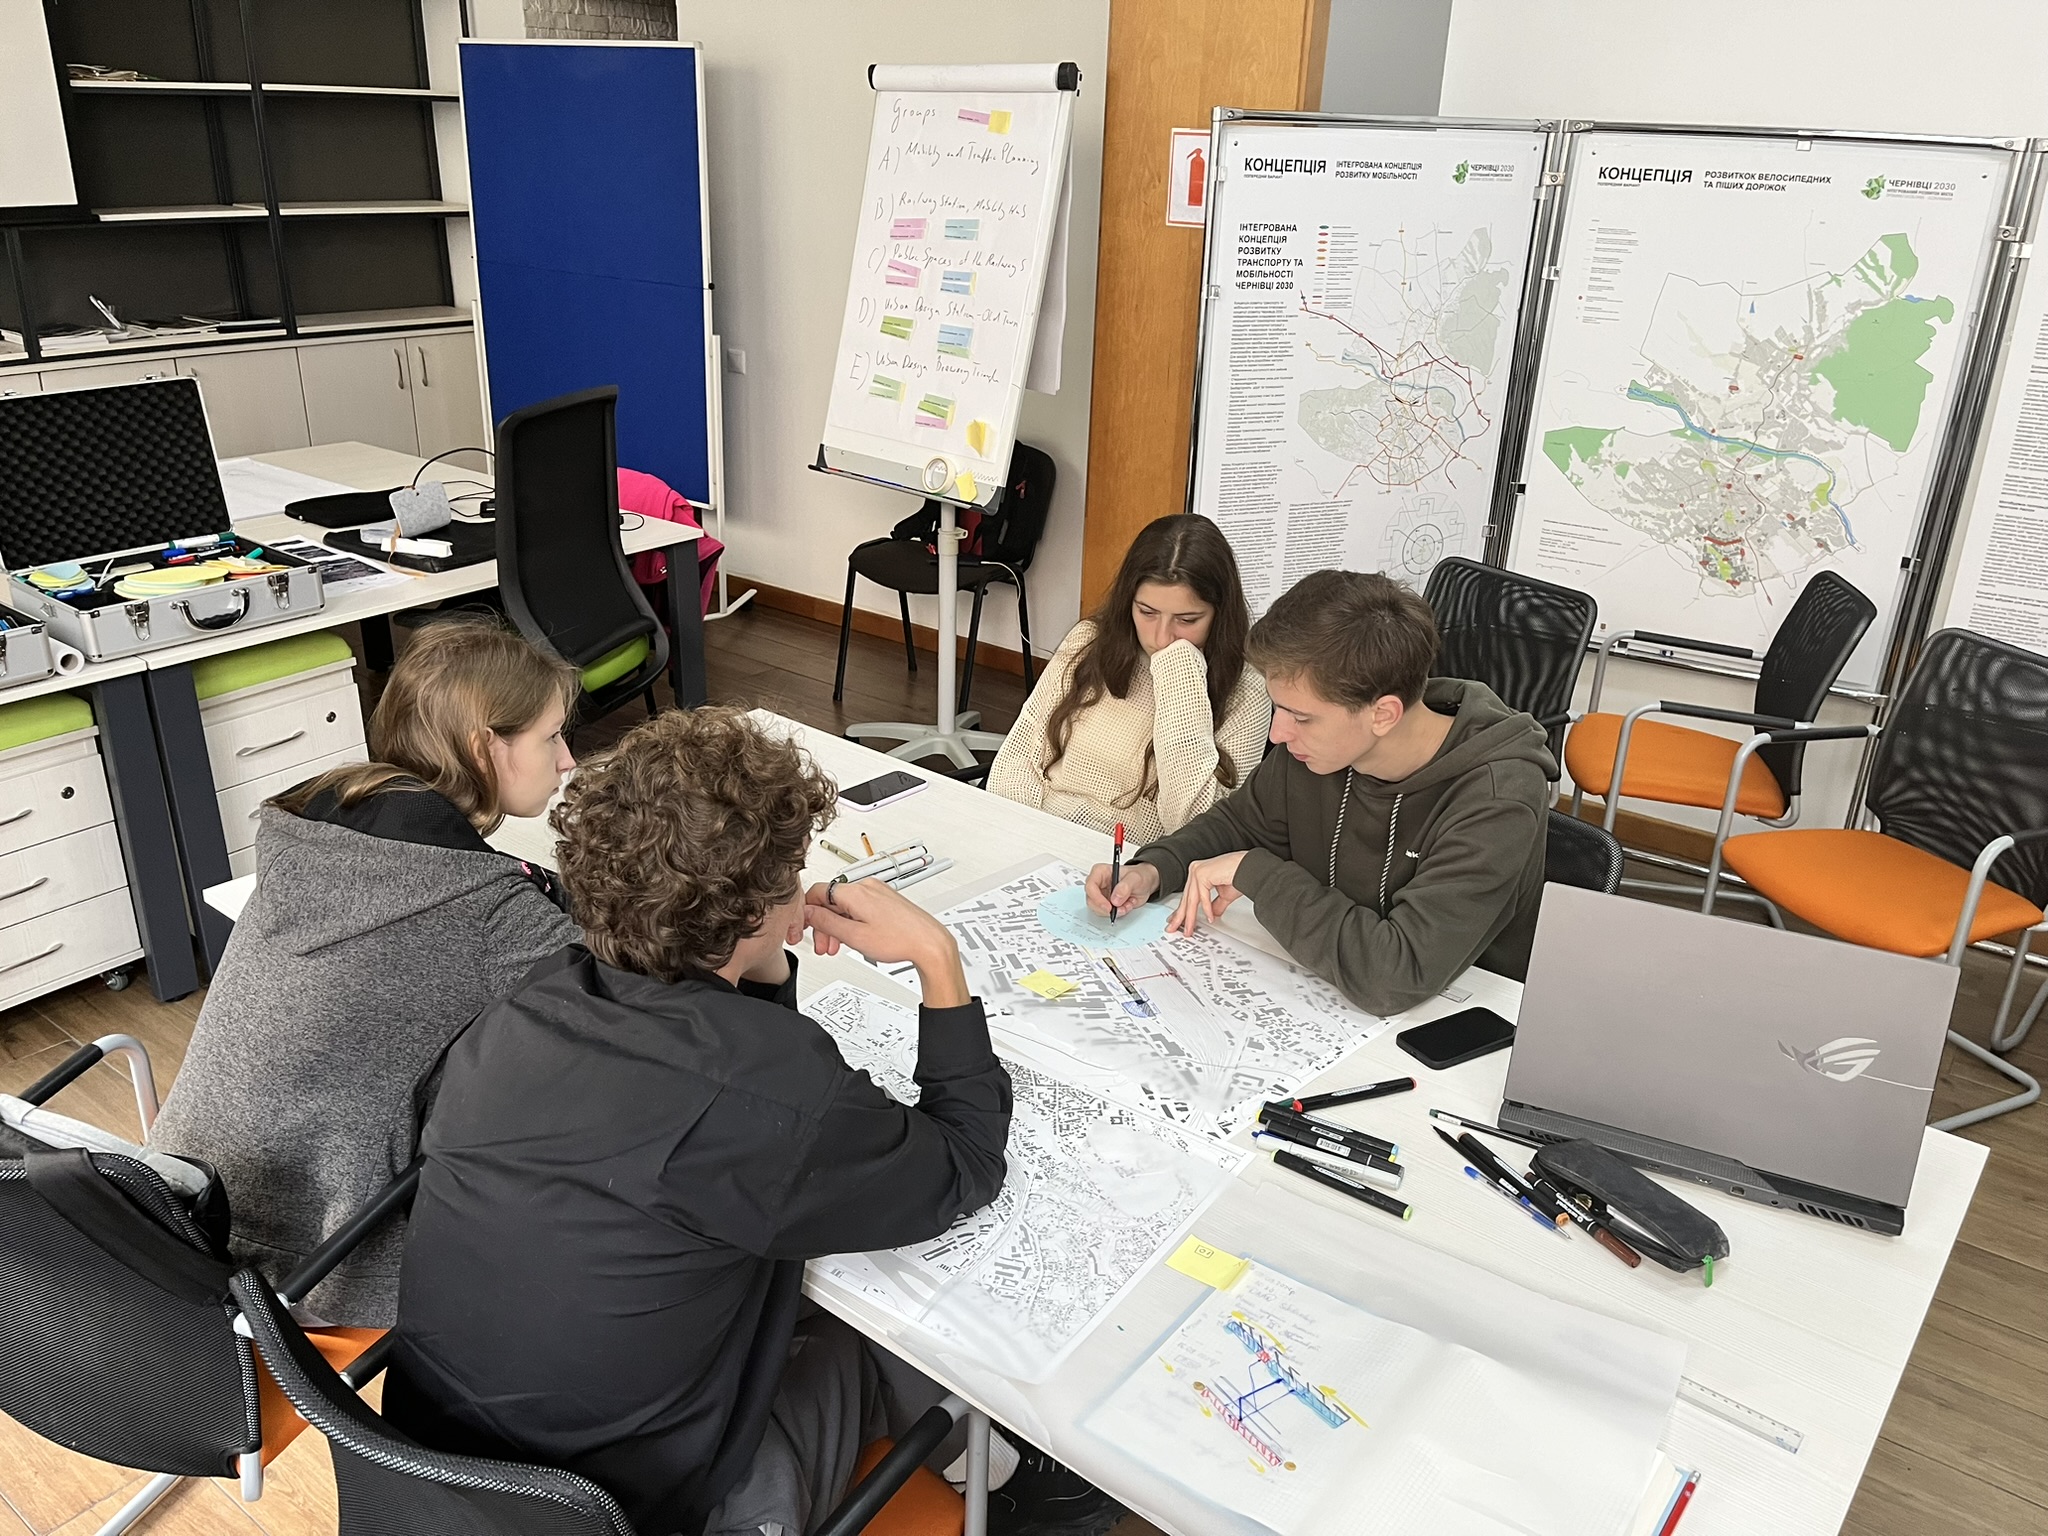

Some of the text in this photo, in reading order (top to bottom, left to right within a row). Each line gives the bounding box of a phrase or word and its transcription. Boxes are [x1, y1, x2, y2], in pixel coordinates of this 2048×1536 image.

[891, 98, 936, 133] Groups
[947, 147, 964, 157] and
[968, 141, 996, 163] Traffic
[1001, 142, 1039, 175] Planning
[1244, 157, 1422, 175] КОНЦЕПЦІЯ ІНТЕГРОВАНА КОНЦЕПЦІЯ
[1500, 164, 1514, 172] 2030
[1335, 171, 1418, 180] РОЗВИТКУ МОБІЛЬНОСТІ
[1599, 166, 1693, 185] КОНЦЕПЦІЯ
[1758, 173, 1832, 184] ВЕЛОСИПЕДНИХ
[1715, 181, 1744, 190] ПІШИХ
[1745, 182, 1787, 192] ДОРІЖОК
[1888, 179, 1956, 191] ЧЕРНІВЦІ 2030
[899, 191, 937, 214] Railway
[1239, 223, 1298, 232] ІНТЕГРОВАНА
[1238, 235, 1288, 244] КОНЦЕПЦІЯ
[1238, 246, 1282, 255] РОЗВИТКУ
[893, 243, 919, 262] Public
[922, 247, 952, 269] Spaces
[985, 253, 1017, 278] Railway
[1237, 258, 1304, 267] ТРАНСПОРТУ ТА
[1236, 269, 1294, 278] МОБІЛЬНОСТІ
[1235, 281, 1294, 290] ЧЕРНІВЦІ 2030
[915, 296, 940, 320] Design
[902, 355, 928, 378] Design
